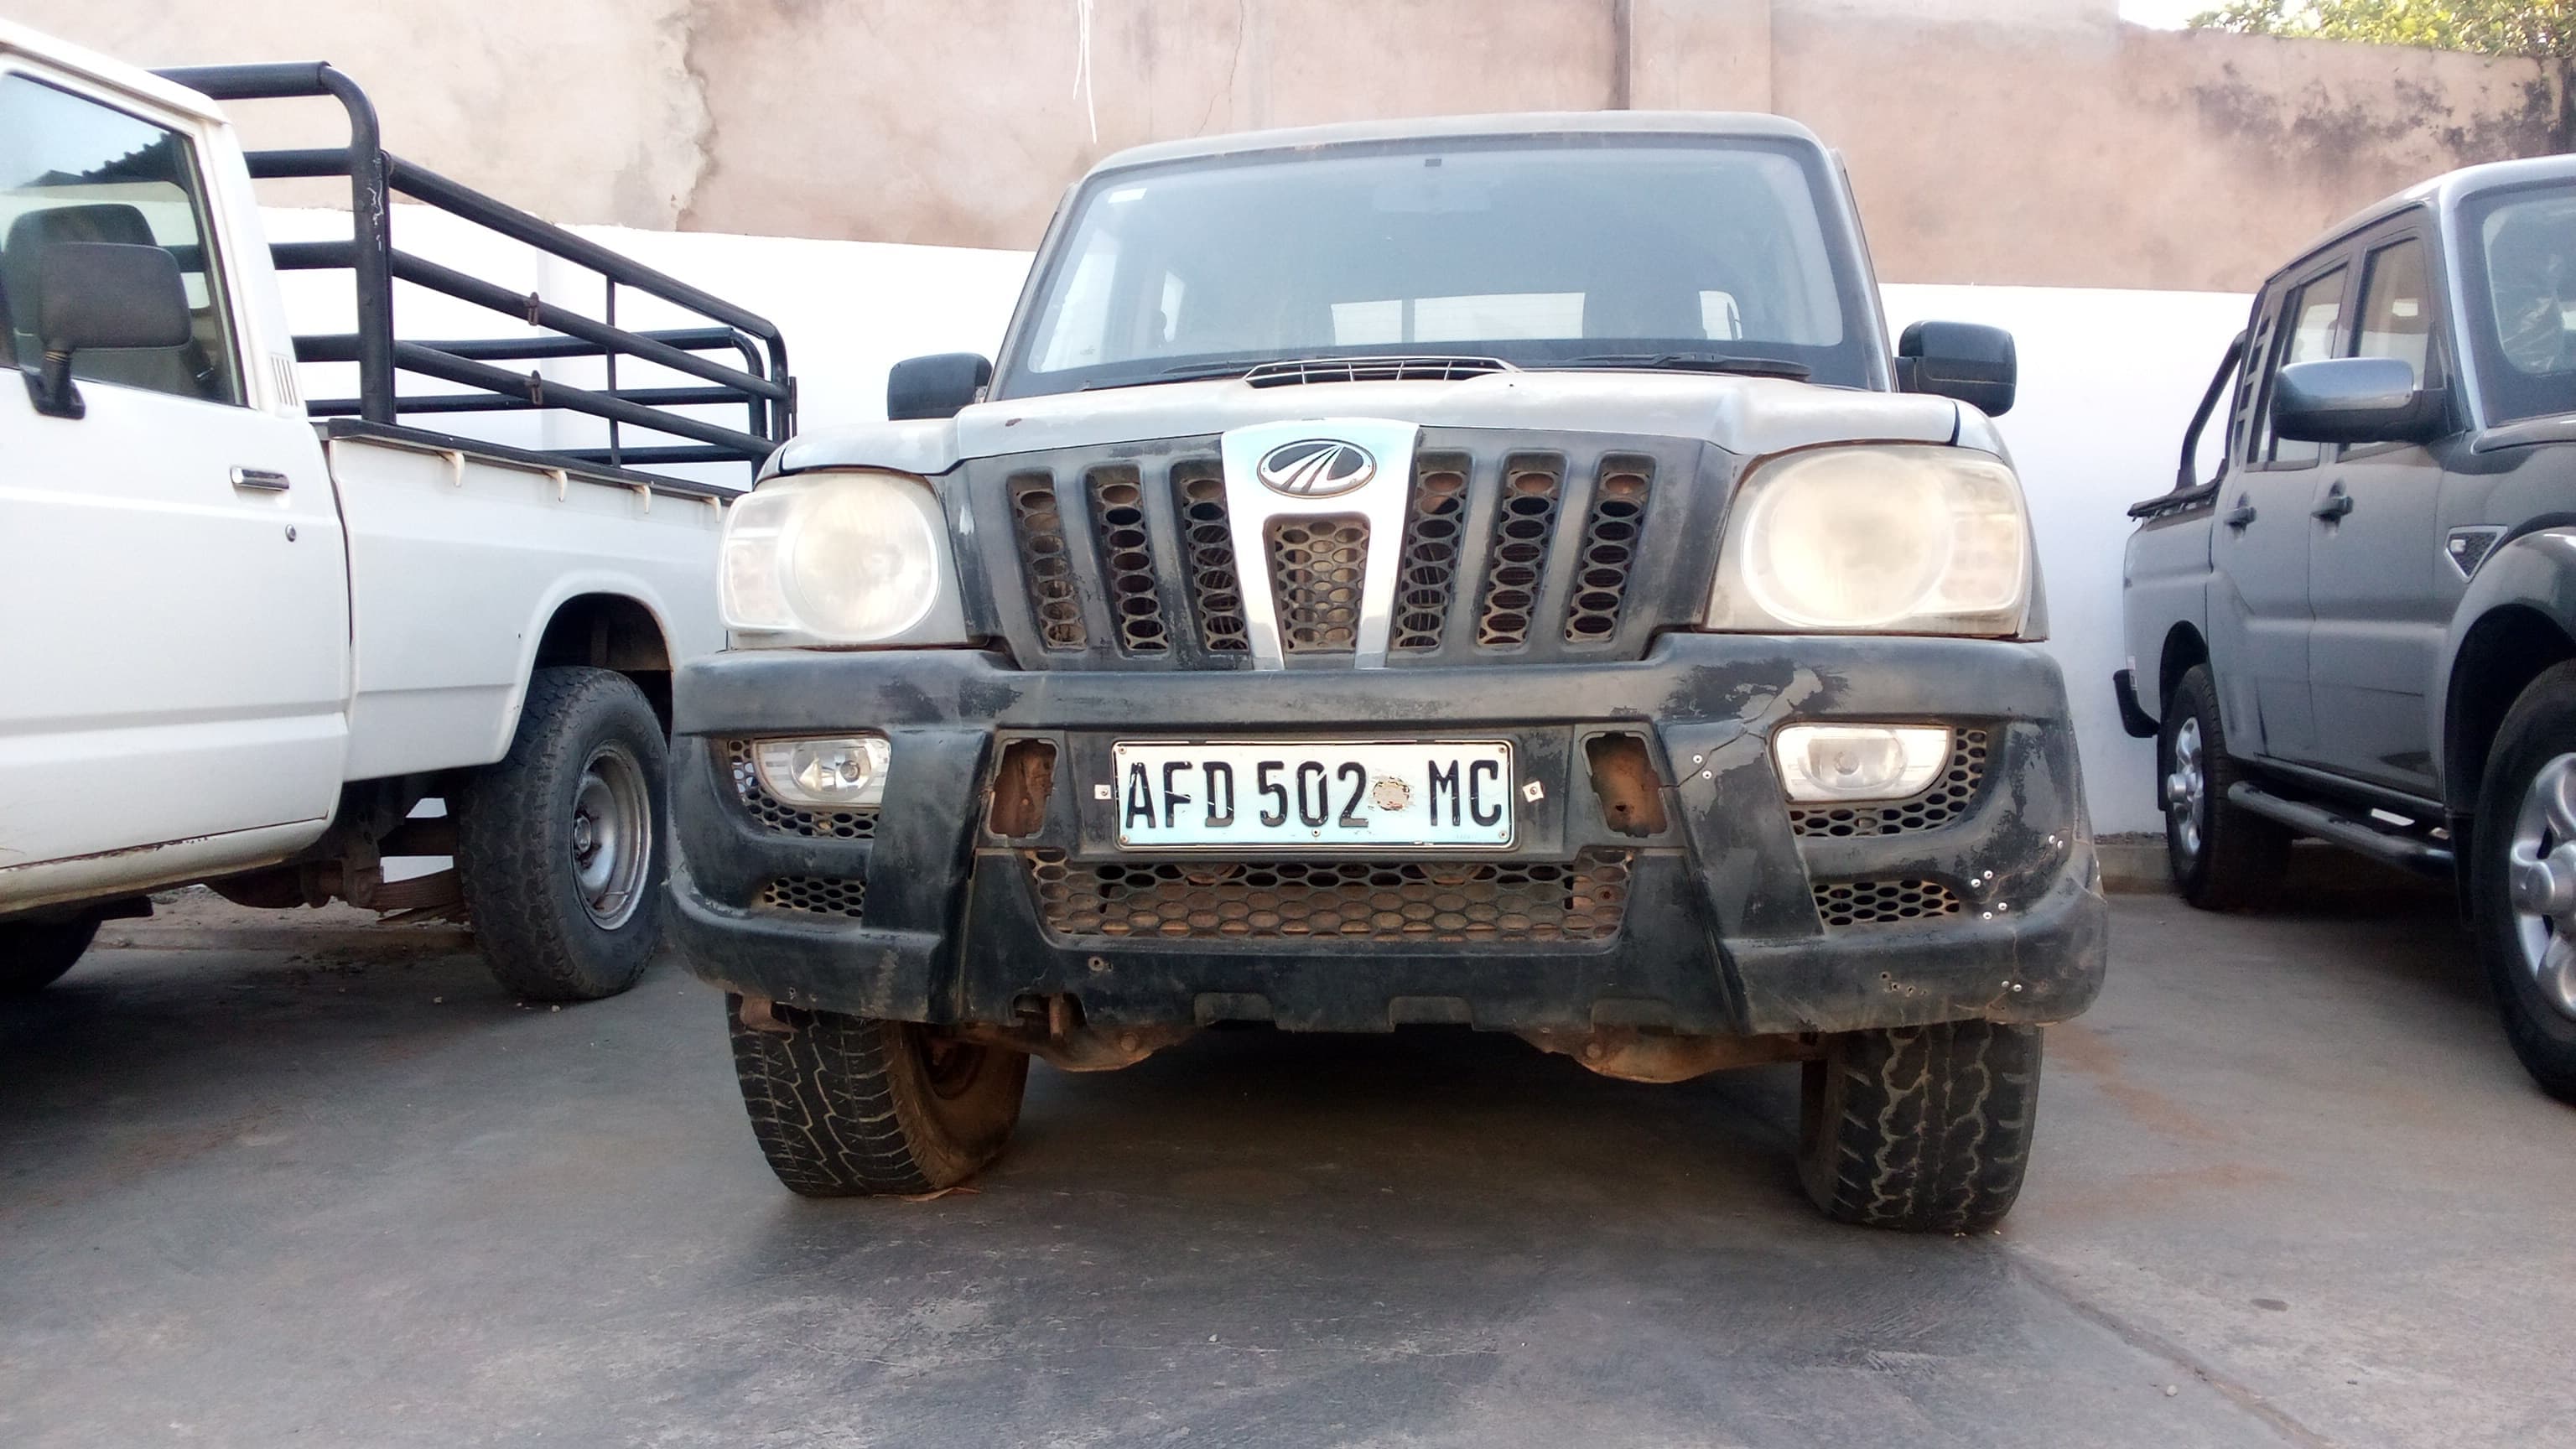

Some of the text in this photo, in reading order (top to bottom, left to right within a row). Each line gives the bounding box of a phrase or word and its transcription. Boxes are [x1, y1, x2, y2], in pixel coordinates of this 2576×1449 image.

[1125, 759, 1502, 828] AFD 502 MC
